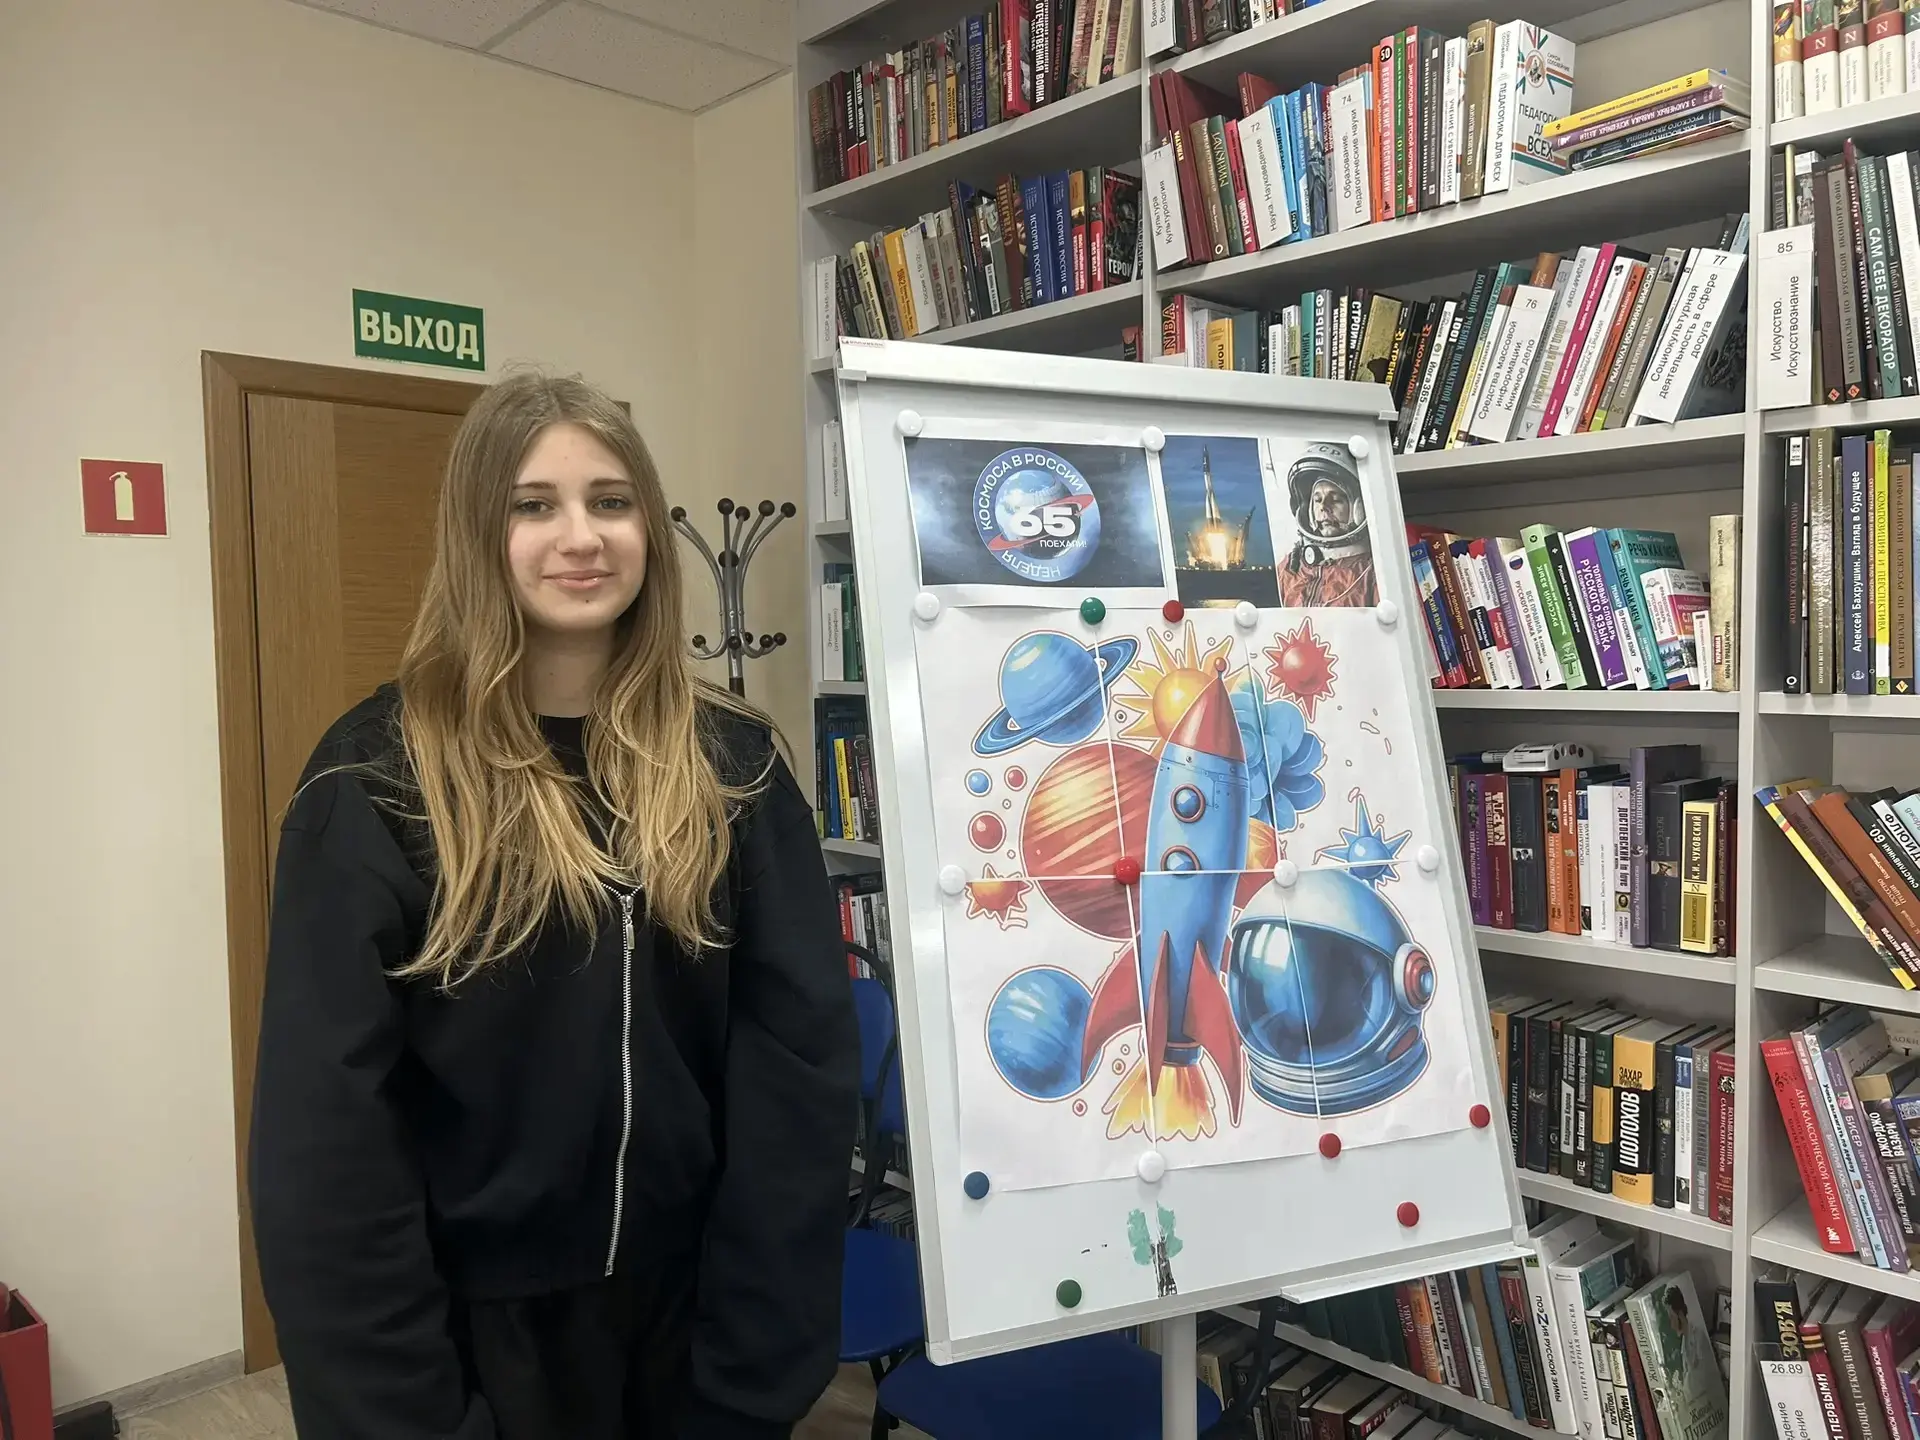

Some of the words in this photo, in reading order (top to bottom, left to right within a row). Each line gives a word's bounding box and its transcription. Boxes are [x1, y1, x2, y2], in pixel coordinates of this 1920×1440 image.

[1035, 2, 1045, 70] ОТЕЧЕСТВЕННАЯ
[1380, 47, 1392, 61] 50
[975, 44, 983, 118] ОТЕЧЕСТВЕННОЙ
[1034, 73, 1044, 103] ВОЙНА
[1340, 94, 1352, 104] 74
[1382, 66, 1391, 105] ВЕЛИКИХ
[1349, 108, 1361, 137] науки
[1382, 107, 1391, 130] КНИГ
[1447, 98, 1455, 130] УЧЕНИЕ
[1494, 82, 1507, 140] ПЕДАГОГИКА
[1151, 151, 1162, 159] 71
[1339, 132, 1352, 199] Образование.
[1383, 140, 1392, 193] ВОСПИТАНИИ
[1445, 138, 1454, 193] УВЛЕЧЕНИЕМ
[1493, 141, 1503, 160] ДЛЯ
[1526, 135, 1554, 162] ВСЕХ
[1254, 138, 1273, 200] Науковедение
[1349, 138, 1363, 214] Педагогические
[1492, 161, 1502, 182] ВСЕХ
[1867, 163, 1878, 193] НАТАЛЬЯ
[1158, 180, 1173, 245] Культурология
[1833, 179, 1846, 249] ИКОНОГРАФИИ
[1860, 165, 1873, 224] ПРЕОБРАЖЕНСКАЯ
[1030, 213, 1040, 250] ИСТОРИЯ
[1055, 208, 1065, 246] ИСТОРИЯ
[1151, 196, 1162, 236] Культура
[1264, 201, 1278, 232] Наука.
[1711, 253, 1728, 265] 77
[1777, 240, 1793, 254] 85
[1867, 226, 1883, 258] САМ
[1032, 253, 1042, 286] РОССИИ
[1058, 248, 1067, 283] РОССИИ
[1838, 251, 1849, 295] РУССКОЙ
[1872, 260, 1887, 293] СЕБЕ
[1888, 260, 1900, 289] Пабло
[1467, 274, 1486, 314] БОЛЬШОЙ
[1524, 298, 1538, 310] 76
[1637, 267, 1657, 304] ИСТОРИЯ
[1315, 293, 1326, 356] РЕЛЬЕФ
[1620, 304, 1645, 344] КНИЖНОЙ
[1843, 299, 1851, 314] ПО
[1892, 289, 1905, 327] Пикассо
[359, 308, 479, 362] ВЫХОД
[1162, 302, 1177, 351] NBA
[1455, 315, 1477, 351] УЧЕБНИК
[1551, 319, 1569, 344] ПОВОД
[1649, 284, 1700, 382] Социокультурная
[1657, 319, 1702, 399] деятельность
[1696, 272, 1719, 313] сфере
[1689, 320, 1714, 359] досуга
[1770, 297, 1784, 361] Искусство.
[1786, 275, 1801, 378] Искусствознание
[1844, 317, 1856, 373] МАТЕРИАЛЫ
[1875, 294, 1897, 370] ДЕКОРАТОР
[1403, 336, 1427, 406] «КОМАНДЫ»
[1422, 360, 1438, 383] Йога
[1477, 371, 1501, 420] Средства
[1491, 320, 1519, 369] массовой
[1546, 344, 1562, 360] ДЛЯ
[1608, 344, 1631, 384] КУЛЬТУРЫ
[1441, 352, 1467, 402] ШАХМАТНОЙ
[1494, 338, 1526, 408] информации.
[1503, 359, 1529, 412] Книжное
[1519, 338, 1536, 360] дело
[1530, 360, 1556, 409] ОПТИМИЗМА?
[1418, 383, 1432, 404] 365
[1433, 403, 1450, 426] ИГРЫ
[978, 461, 1013, 531] КОСМОСА
[1011, 455, 1023, 467] В
[1024, 453, 1084, 491] РОССИИ
[1850, 471, 1862, 513] будущее
[1895, 474, 1904, 543] ИКОНОГРАФИИ
[1009, 506, 1076, 538] 65
[1789, 501, 1800, 547] АНАТОМИЯ
[1850, 524, 1862, 556] Взгляд
[1877, 491, 1886, 555] КОМПОЗИЦИЯ
[1001, 549, 1061, 578] НЕДЕЛЯ
[1039, 539, 1088, 549] ПОЕХАЛИ!
[1790, 548, 1800, 564] ДЛЯ
[1535, 565, 1549, 588] ЯЗЫК
[1851, 558, 1862, 610] Бахрушин.
[1895, 549, 1904, 590] РУССКОЙ
[1439, 552, 1447, 565] Три
[1443, 566, 1454, 593] склянки
[1449, 594, 1465, 630] пополудни
[1514, 580, 1529, 614] РУССКОГО
[1524, 614, 1535, 637] ЯЗЫКА
[1524, 590, 1535, 603] ВСЕ
[1542, 589, 1560, 628] РУССКИЙ
[1579, 558, 1599, 613] РУССКОГО
[1594, 614, 1612, 652] ЯЗЫКА
[1591, 564, 1608, 604] ТОЛКОВЫЙ
[1601, 605, 1616, 641] СЛОВАРЬ
[1619, 567, 1630, 587] РЕЧЬ
[1625, 587, 1635, 604] КАК
[1631, 604, 1641, 622] МЕЧ
[1789, 566, 1799, 625] ХУДОЖНИКОВ
[1877, 570, 1886, 632] ПЕРСПЕКТИВА
[1896, 595, 1904, 609] ПО
[1528, 604, 1542, 634] ПРАВИЛА
[1851, 612, 1862, 652] Алексей
[1896, 613, 1905, 669] МАТЕРИАЛЫ
[1492, 792, 1506, 846] КАРТА
[1635, 780, 1644, 829] ПУШКИНЫМ
[1618, 807, 1630, 861] ДОСТОЕВСКИЙ
[1690, 815, 1702, 861] ЧУКОВСКИЙ
[1619, 872, 1630, 887] love
[1620, 863, 1630, 871] in
[1691, 862, 1700, 880] К.И.
[1618, 1066, 1643, 1083] ЗАХАР
[1794, 1088, 1809, 1108] ДНК
[1619, 1091, 1640, 1168] ШОЛОХОВ
[1799, 1109, 1829, 1181] КЛАССИЧЕСКОЙ
[1869, 1111, 1893, 1158] ДЖОРДЖО
[1885, 1121, 1905, 1157] ВАЗАРИ
[1844, 1115, 1863, 1148] БИСЕР
[1856, 1148, 1871, 1171] цветы
[1864, 1179, 1883, 1211] деревья
[1823, 1181, 1841, 1221] МУЗЫКИ
[1897, 1204, 1915, 1234] ВЕЛИКИЕ
[1430, 1284, 1437, 1296] НЕ
[1404, 1304, 1414, 1332] СЛАВА
[1434, 1300, 1448, 1334] КАРТАХ
[1568, 1303, 1580, 1336] МОСКВА
[1631, 1310, 1651, 1349] Пушкин
[1442, 1338, 1450, 1350] НА
[1567, 1339, 1576, 1365] АТЛАС
[1543, 1340, 1557, 1376] РУССКОЙ
[1550, 1377, 1562, 1402] ЗИМЫ
[1573, 1338, 1589, 1402] ЛИТЕРАТУРНАЯ
[1641, 1349, 1659, 1382] Живой
[1770, 1363, 1803, 1374] 26.89
[1605, 1392, 1618, 1426] АХМАТОВА
[1816, 1373, 1842, 1432] ПЕРВЫМИ
